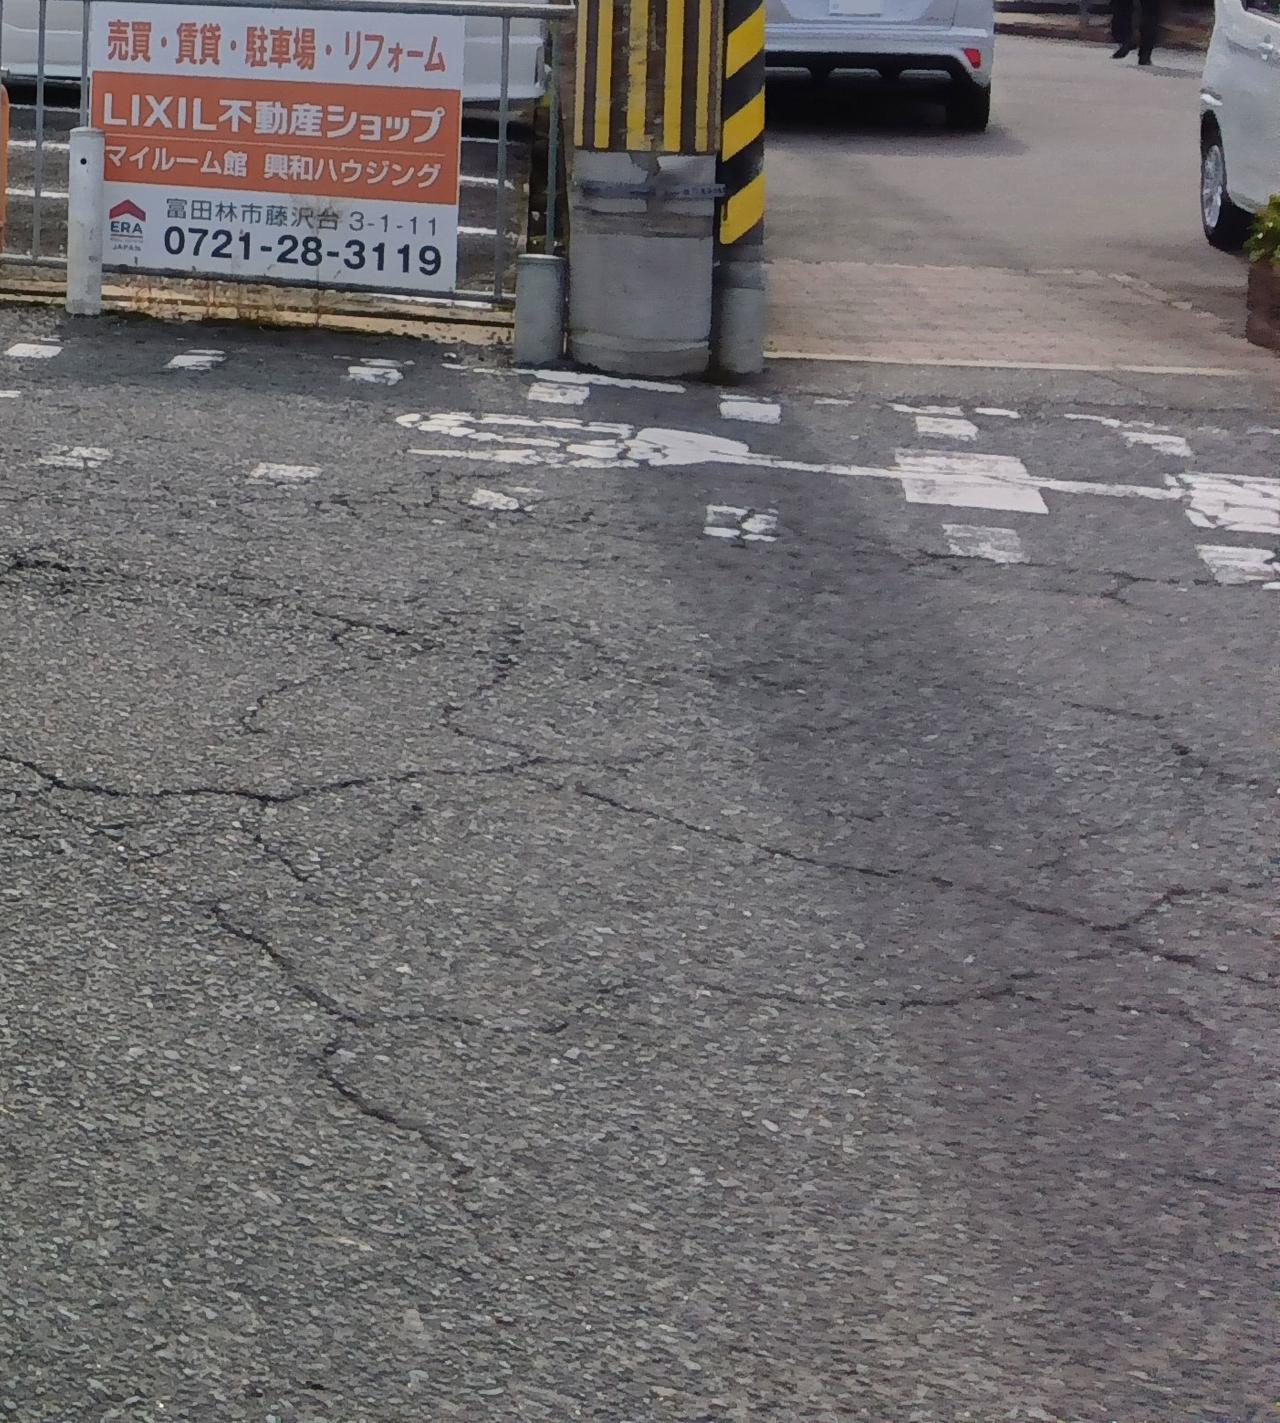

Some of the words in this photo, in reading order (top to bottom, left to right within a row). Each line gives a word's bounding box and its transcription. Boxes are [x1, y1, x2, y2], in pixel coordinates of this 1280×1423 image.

[103, 92, 446, 144] LIXIL不動産ショップ
[105, 144, 248, 178] マイルーム館
[263, 153, 443, 189] 興和ハウジング
[111, 220, 143, 235] ERA
[163, 226, 442, 277] 0721-28-3119
